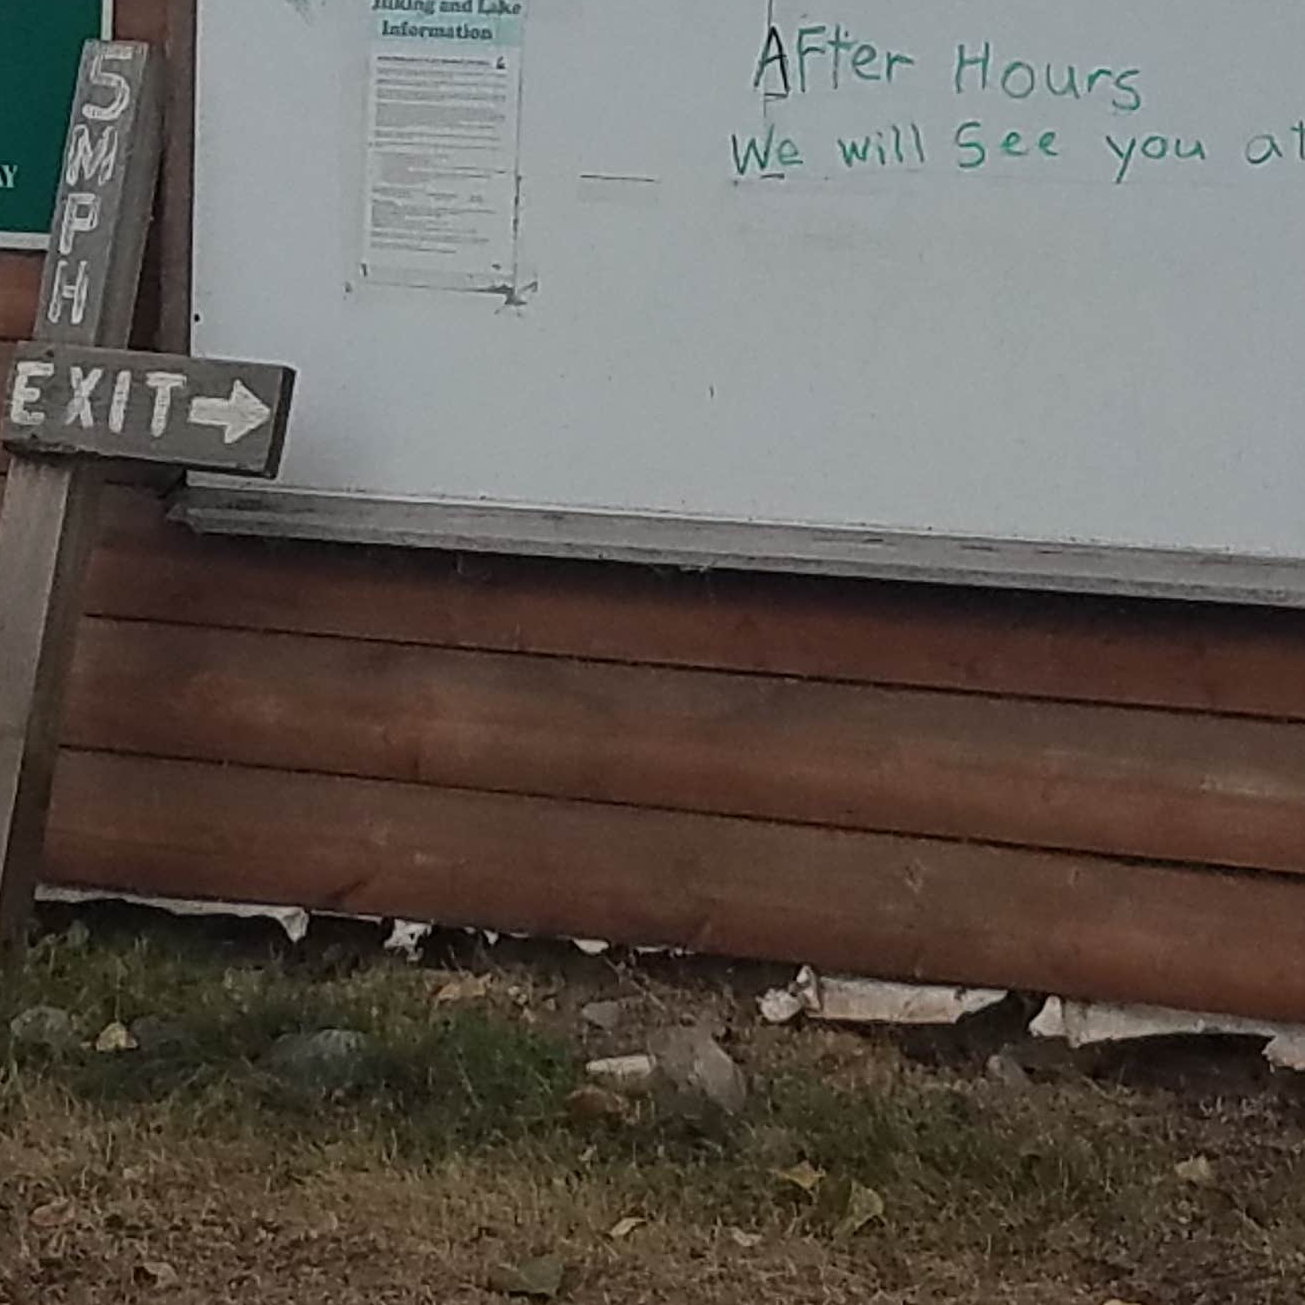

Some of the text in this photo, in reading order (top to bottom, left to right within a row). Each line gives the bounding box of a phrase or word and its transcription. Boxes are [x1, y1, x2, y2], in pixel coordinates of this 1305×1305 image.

[382, 20, 493, 40] Information
[439, 0, 473, 13] and
[955, 42, 1141, 113] Hours
[731, 126, 804, 175] We
[840, 124, 925, 169] will
[1106, 130, 1206, 185] you
[10, 361, 188, 438] EXIT
